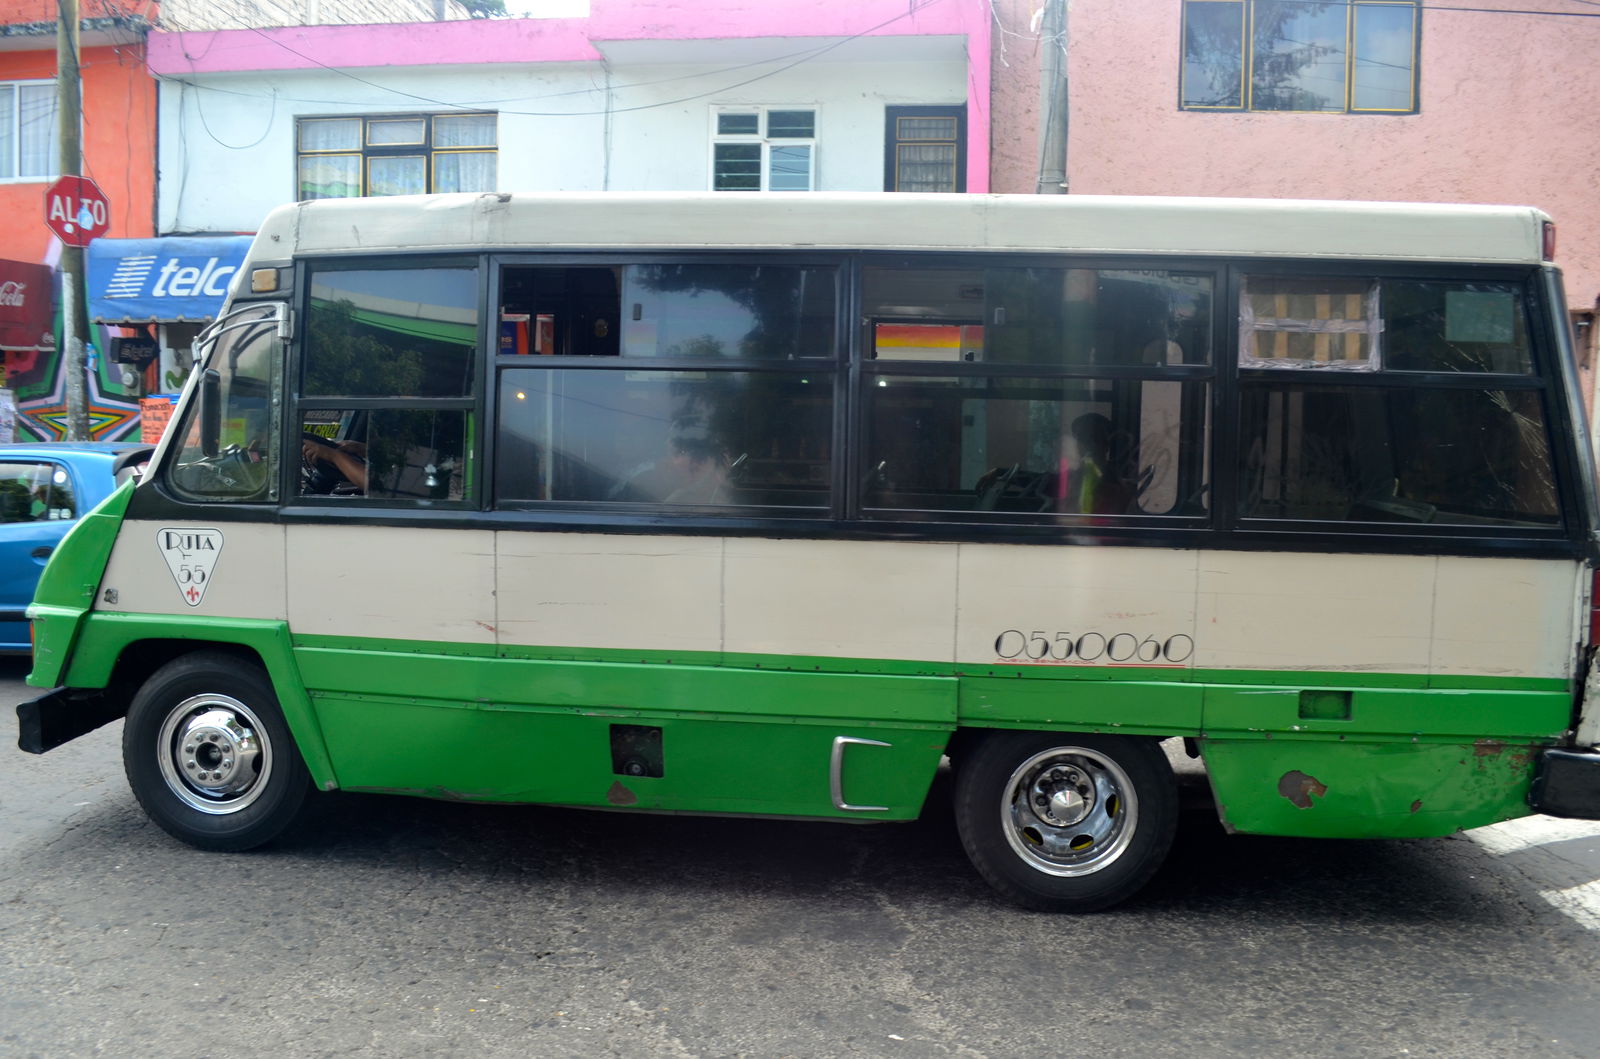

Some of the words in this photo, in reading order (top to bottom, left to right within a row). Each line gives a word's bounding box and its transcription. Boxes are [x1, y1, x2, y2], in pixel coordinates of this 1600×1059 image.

[50, 194, 106, 226] ALTO
[165, 531, 215, 554] RUTA
[177, 564, 206, 584] 55
[994, 629, 1195, 663] 0550060
